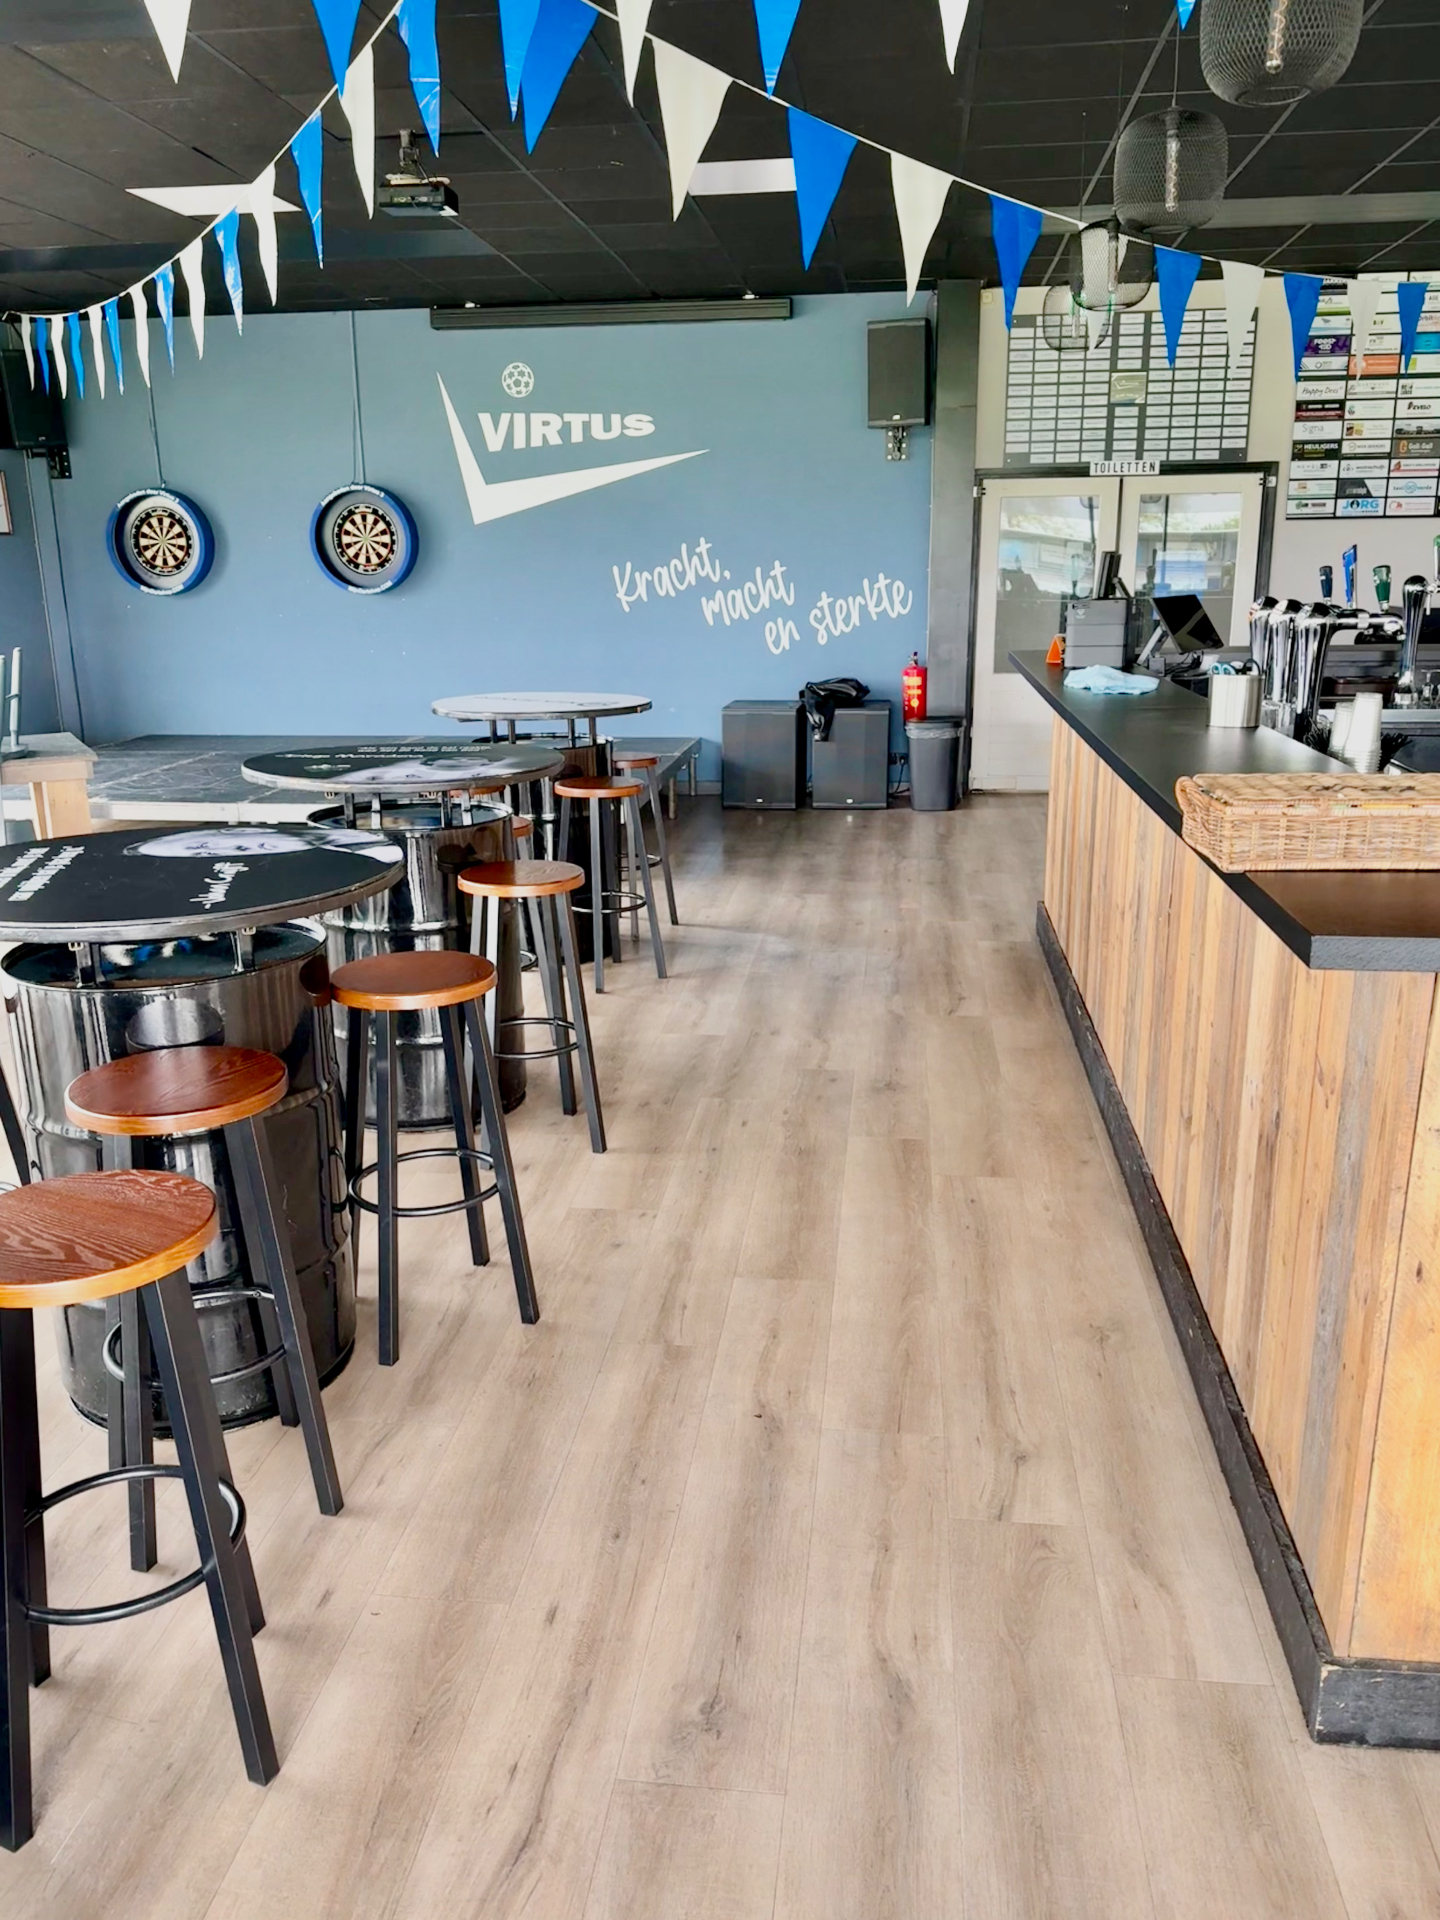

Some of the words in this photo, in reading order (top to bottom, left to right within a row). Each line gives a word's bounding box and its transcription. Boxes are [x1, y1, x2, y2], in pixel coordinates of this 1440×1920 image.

[477, 412, 656, 452] VIRTUS
[1094, 461, 1156, 474] TOILETTEN
[612, 536, 731, 613] Kracht,
[701, 559, 795, 627] macht
[764, 620, 801, 655] en
[808, 572, 913, 645] sterkte
